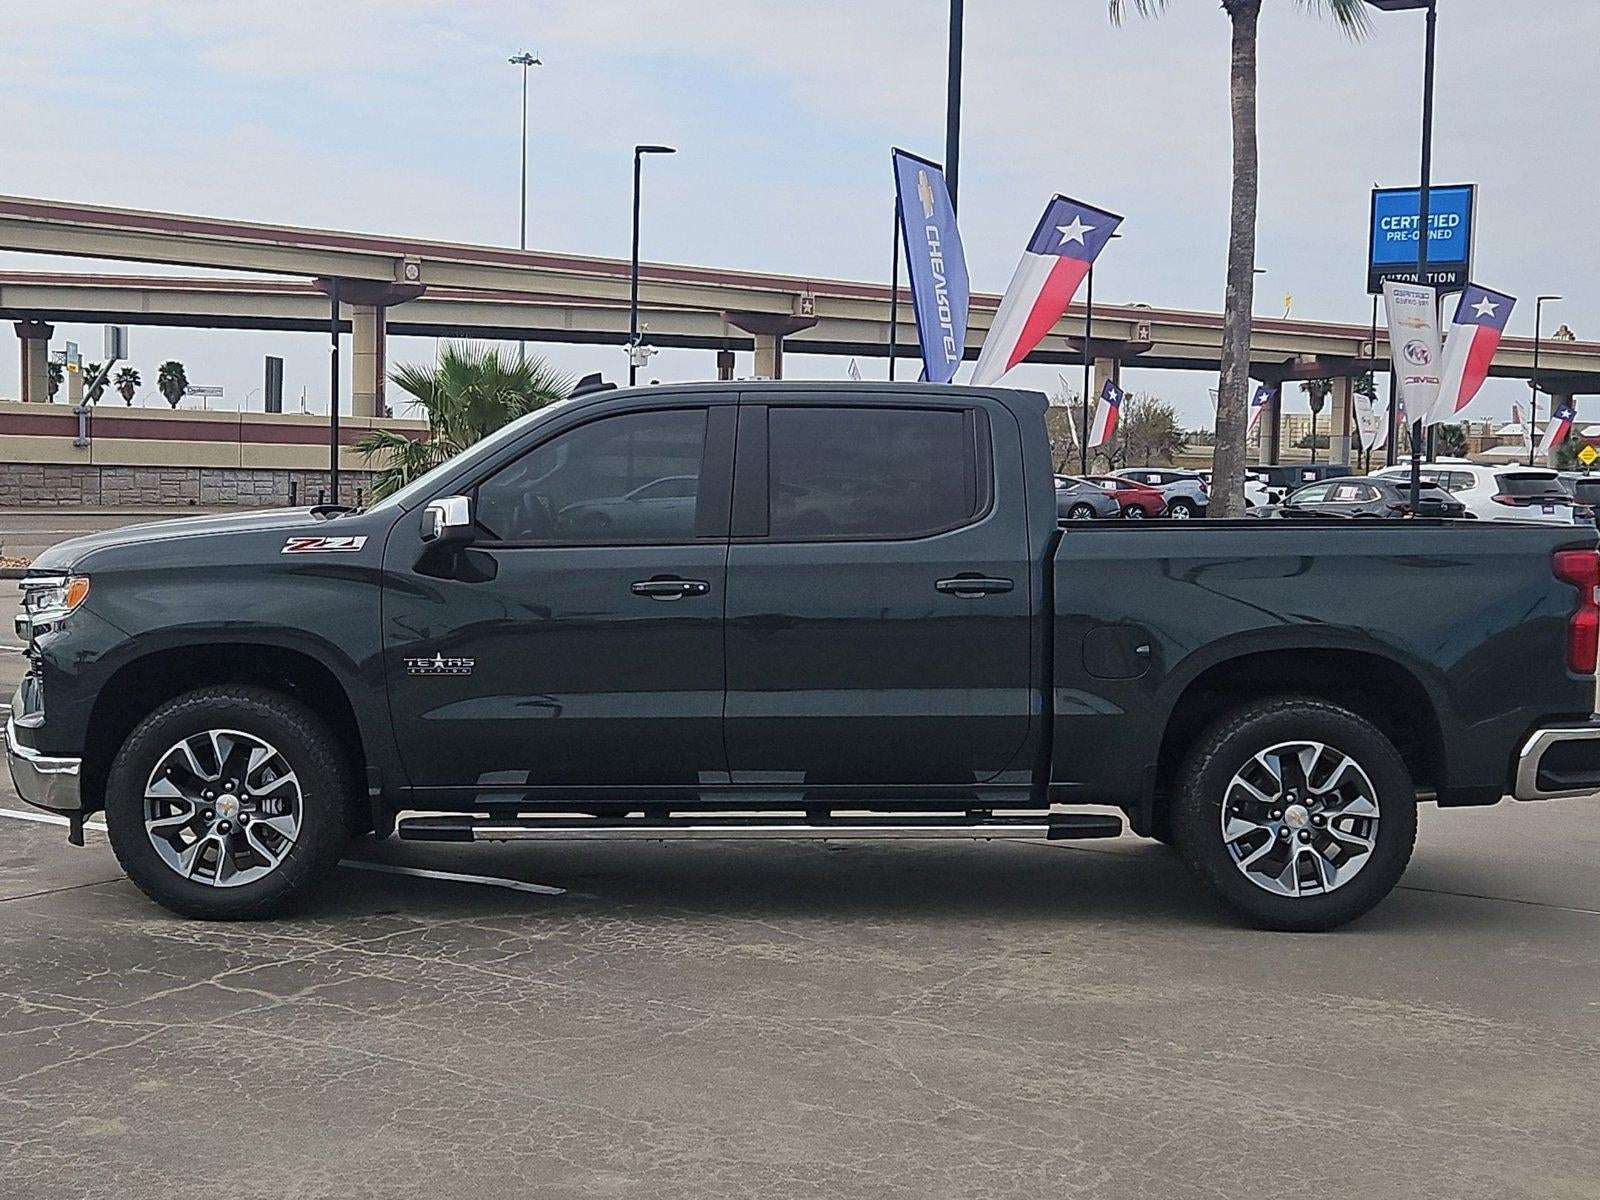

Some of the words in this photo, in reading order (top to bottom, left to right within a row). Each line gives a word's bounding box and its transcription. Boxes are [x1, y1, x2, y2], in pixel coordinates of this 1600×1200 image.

[1381, 214, 1459, 230] CERTFIED
[1386, 229, 1452, 241] PRE-ONED
[1380, 272, 1456, 285] AUTONTION
[281, 536, 369, 554] Z71
[403, 652, 475, 669] TEXAS
